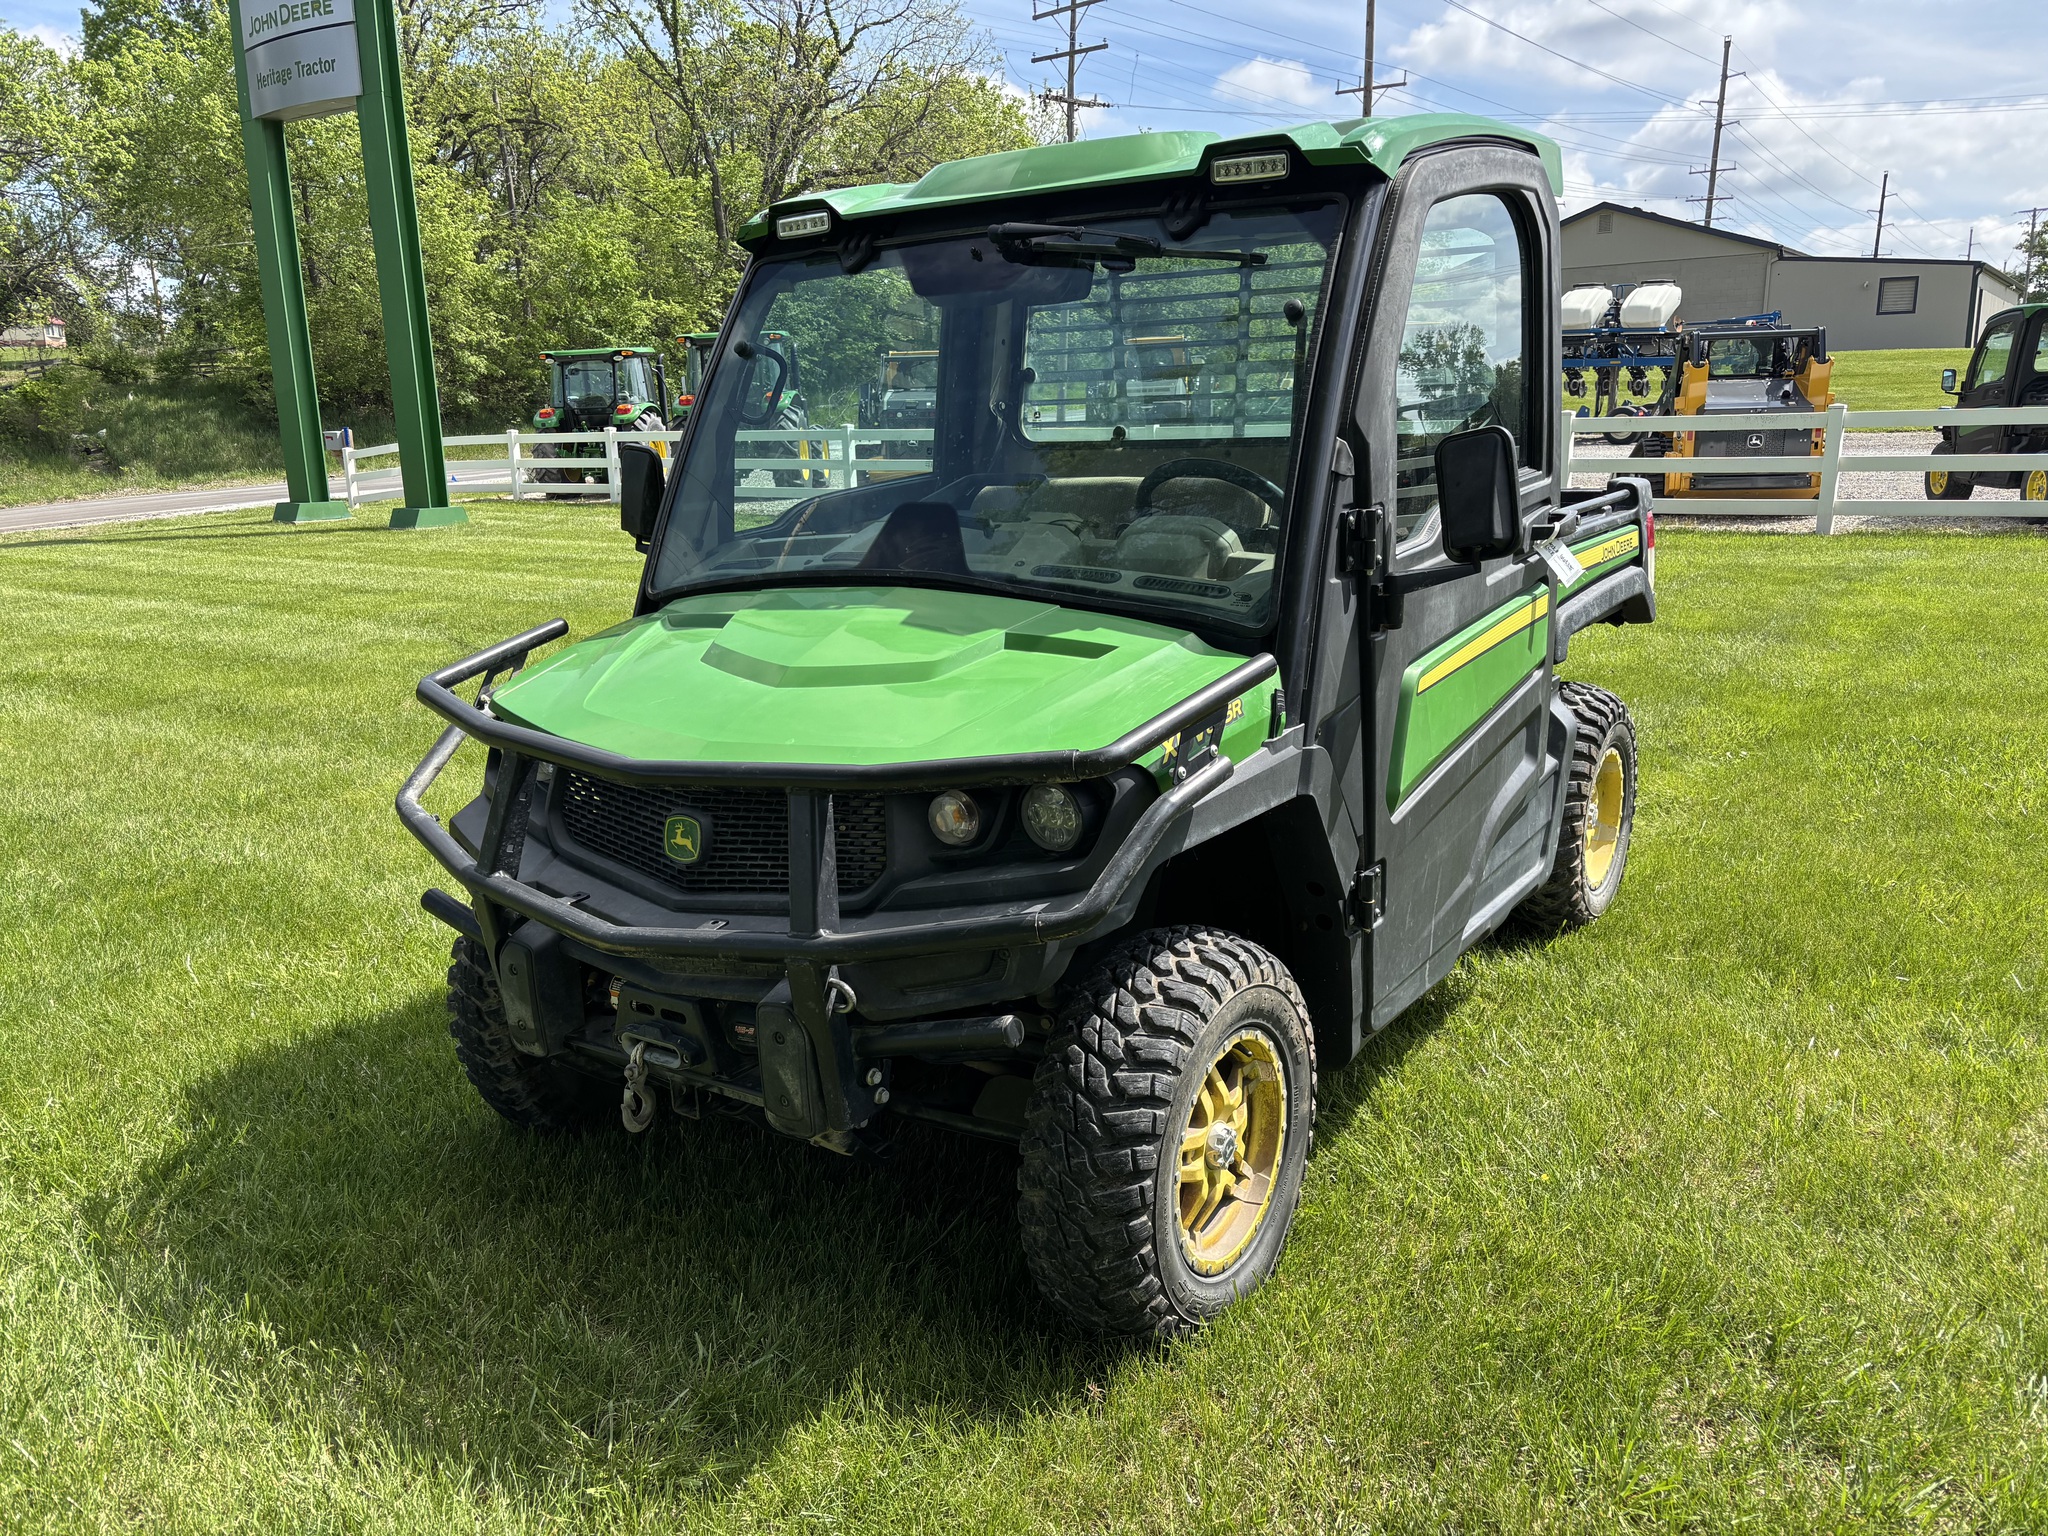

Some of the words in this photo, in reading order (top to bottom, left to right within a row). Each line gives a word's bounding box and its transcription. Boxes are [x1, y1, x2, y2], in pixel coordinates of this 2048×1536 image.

[249, 10, 279, 38] JOHN
[279, 0, 334, 26] DEERE
[256, 67, 293, 90] Heritage
[295, 57, 336, 79] Tractor
[1600, 545, 1616, 563] JOHN
[1615, 537, 1633, 556] DEERE
